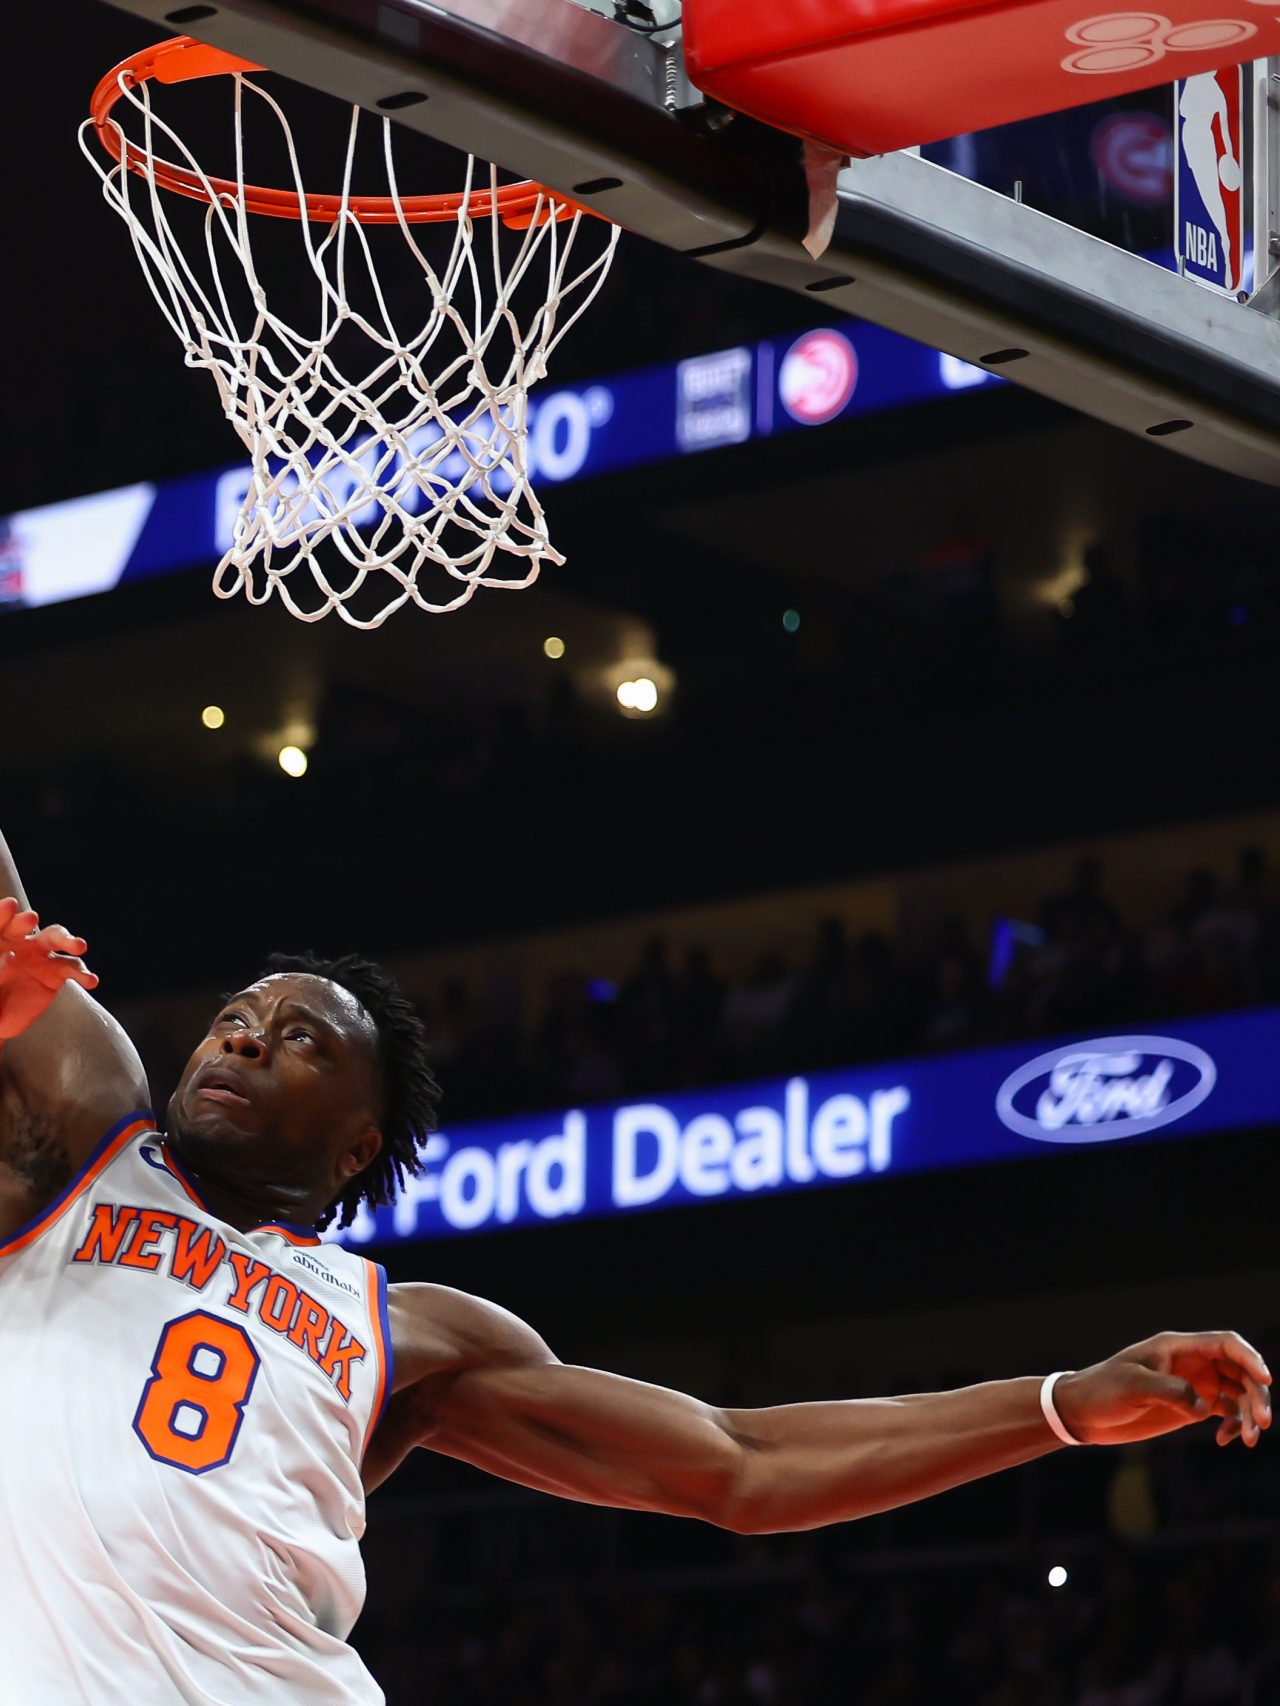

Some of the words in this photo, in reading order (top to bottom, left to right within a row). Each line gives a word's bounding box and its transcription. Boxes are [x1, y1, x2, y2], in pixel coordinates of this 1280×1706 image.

[1185, 221, 1218, 272] NBA
[393, 1107, 587, 1237] Ford
[612, 1075, 911, 1208] Dealer
[72, 1203, 228, 1295] NEW
[223, 1252, 370, 1406] YORK
[293, 1255, 320, 1275] abu
[321, 1271, 361, 1299] dhabi
[132, 1308, 262, 1475] 8
